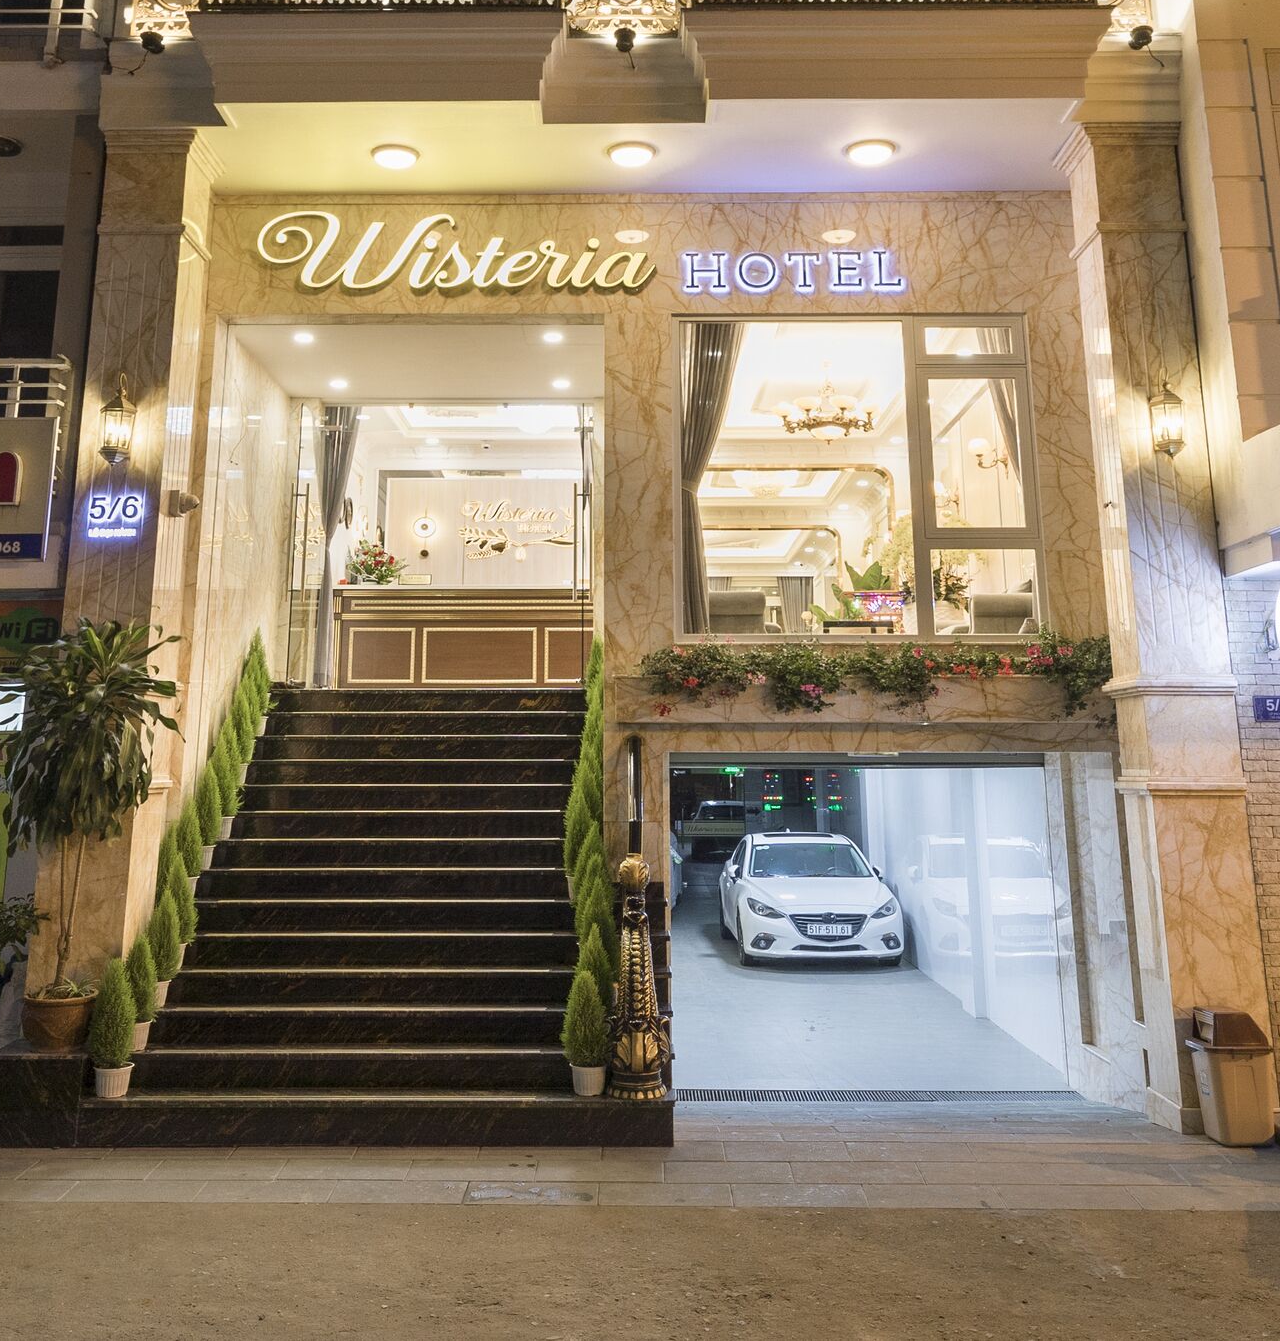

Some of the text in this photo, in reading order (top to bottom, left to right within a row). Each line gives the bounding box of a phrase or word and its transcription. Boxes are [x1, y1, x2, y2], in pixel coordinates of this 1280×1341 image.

[257, 211, 904, 294] Wisteria HOTEL
[89, 495, 139, 519] 5/6
[461, 499, 558, 522] Wisteria
